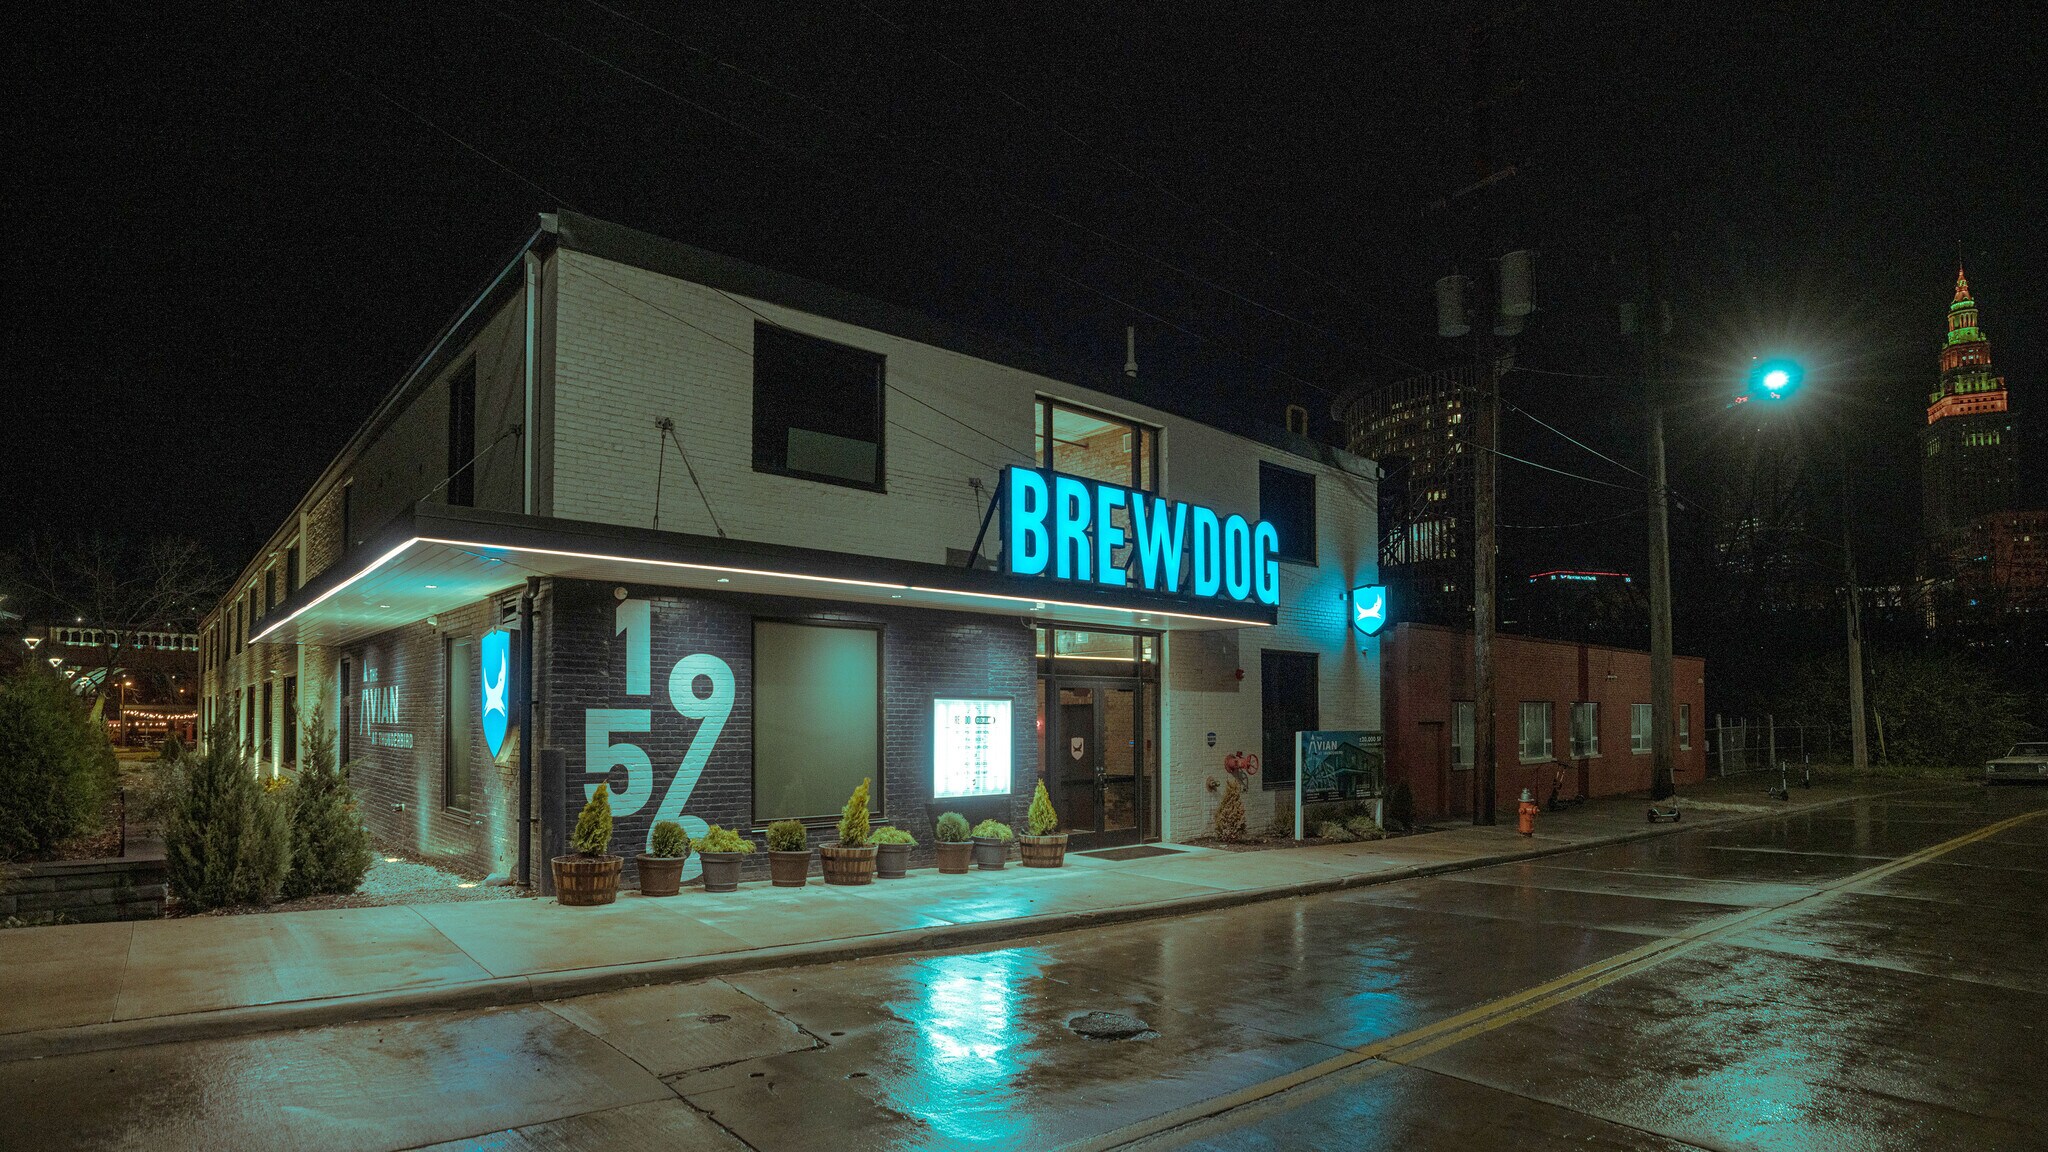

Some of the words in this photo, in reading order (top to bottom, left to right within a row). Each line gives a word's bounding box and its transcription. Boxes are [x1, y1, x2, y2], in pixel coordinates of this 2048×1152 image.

[1011, 466, 1280, 606] BREWDOG
[359, 659, 399, 736] AVIAN
[1308, 734, 1338, 754] AVIAN
